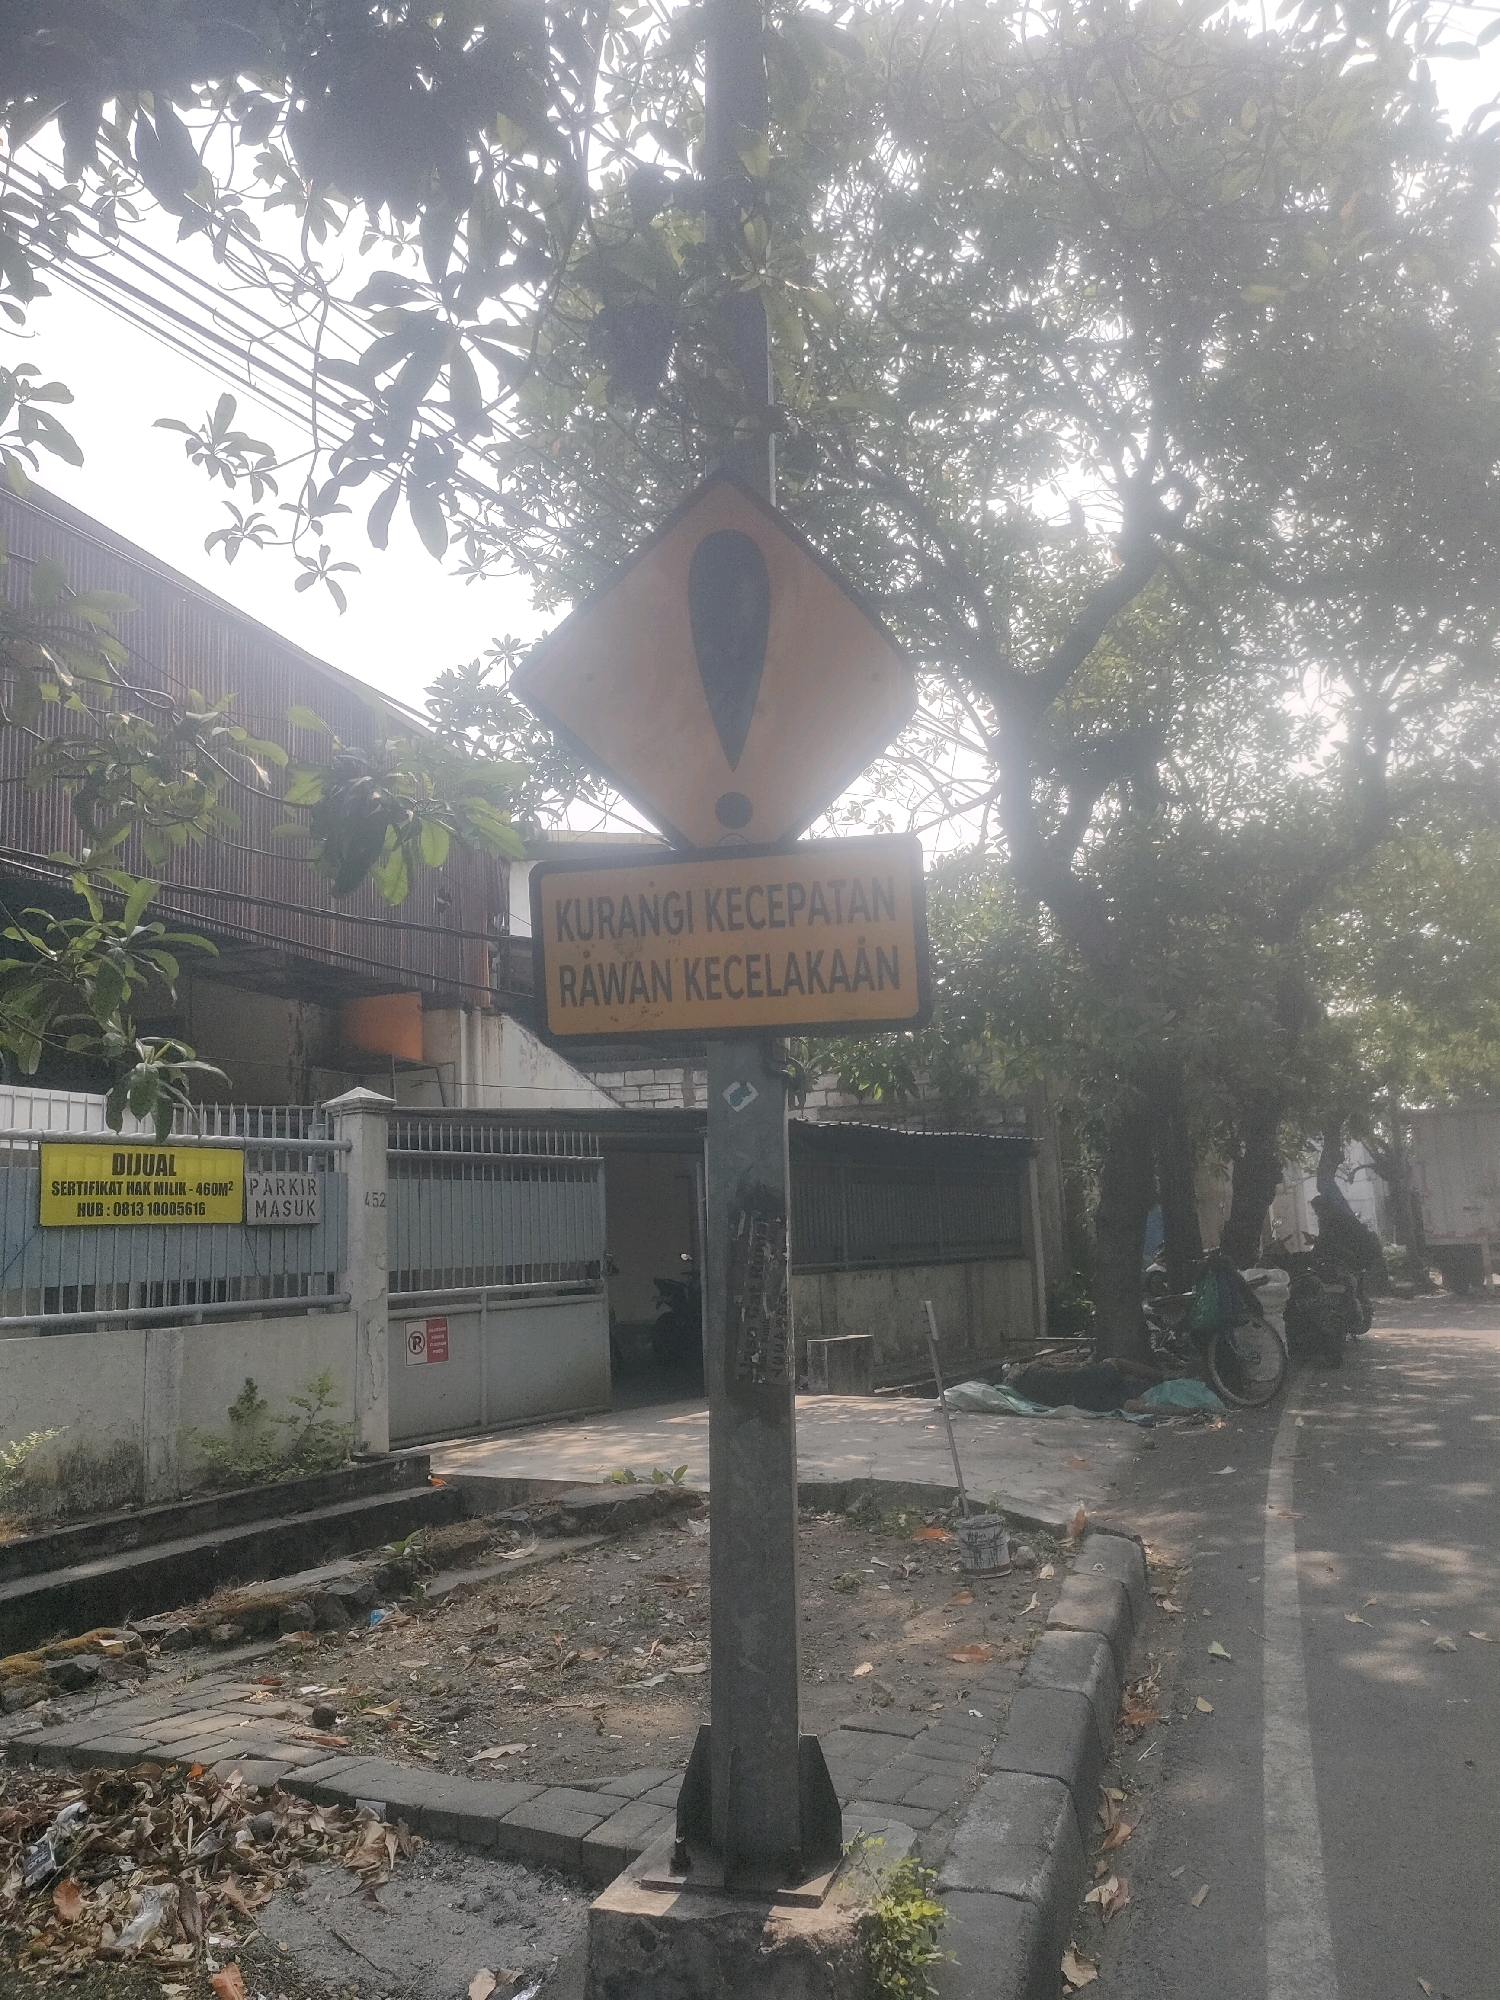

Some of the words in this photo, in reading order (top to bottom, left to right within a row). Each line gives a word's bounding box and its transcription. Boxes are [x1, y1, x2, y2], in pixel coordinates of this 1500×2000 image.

[555, 890, 695, 942] KURANGI
[706, 876, 897, 931] KECEPATAN
[558, 959, 672, 1008] RAWAN
[684, 945, 901, 1001] KECELAKAAN
[111, 1153, 177, 1177] DIJUAL
[51, 1180, 124, 1197] SERTIFIKAT
[126, 1181, 151, 1196] HAK
[153, 1181, 187, 1197] MILIK
[249, 1178, 318, 1196] PARKIR
[364, 1191, 387, 1208] 452
[113, 1202, 144, 1217] 0813
[147, 1201, 206, 1217] 10005616
[255, 1200, 317, 1218] MASUK
